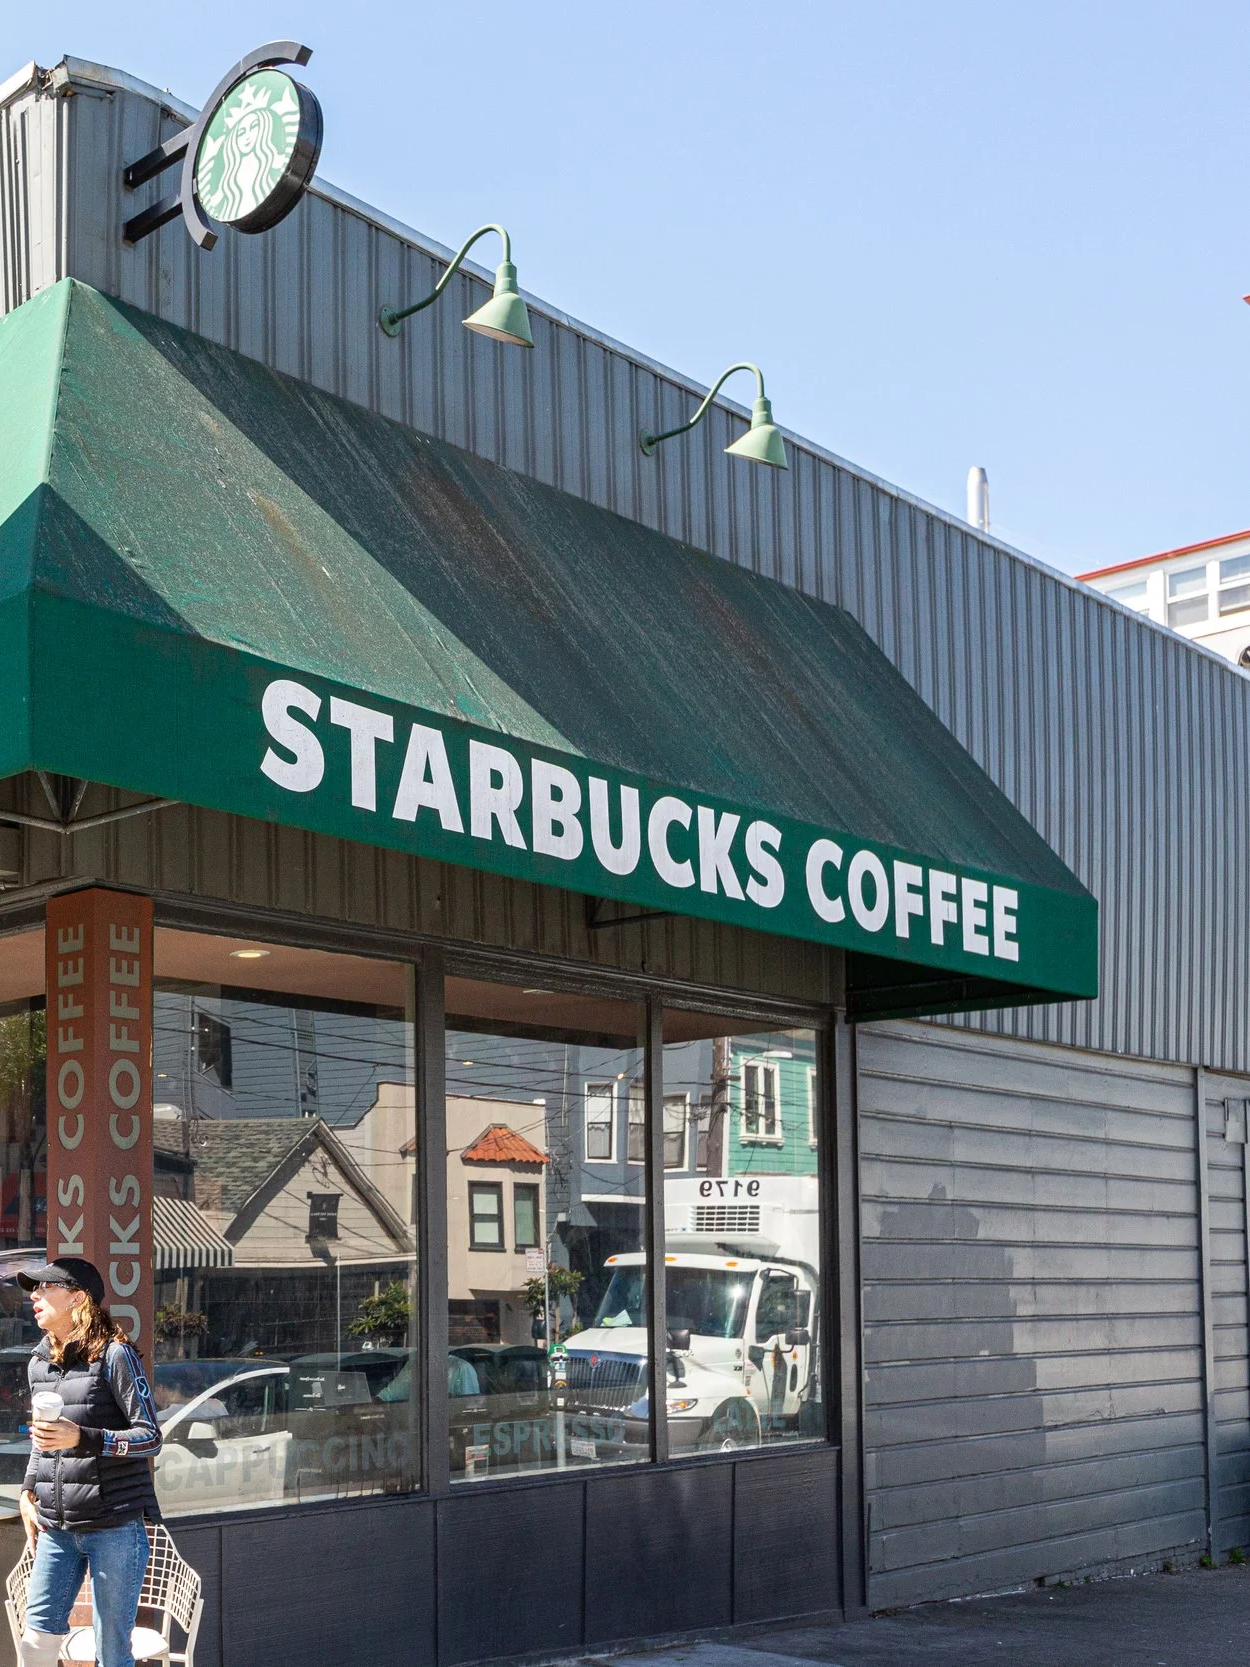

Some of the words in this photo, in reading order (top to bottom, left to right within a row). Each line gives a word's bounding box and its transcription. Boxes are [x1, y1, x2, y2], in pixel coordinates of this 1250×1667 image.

[260, 677, 786, 910] STARBUCKS
[805, 837, 1021, 963] COFFEE
[57, 923, 84, 1150] COFFEE
[108, 923, 141, 1150] COFFEE
[155, 1433, 409, 1491] CAPPUCCINO
[472, 1411, 627, 1456] ESPRESSO
